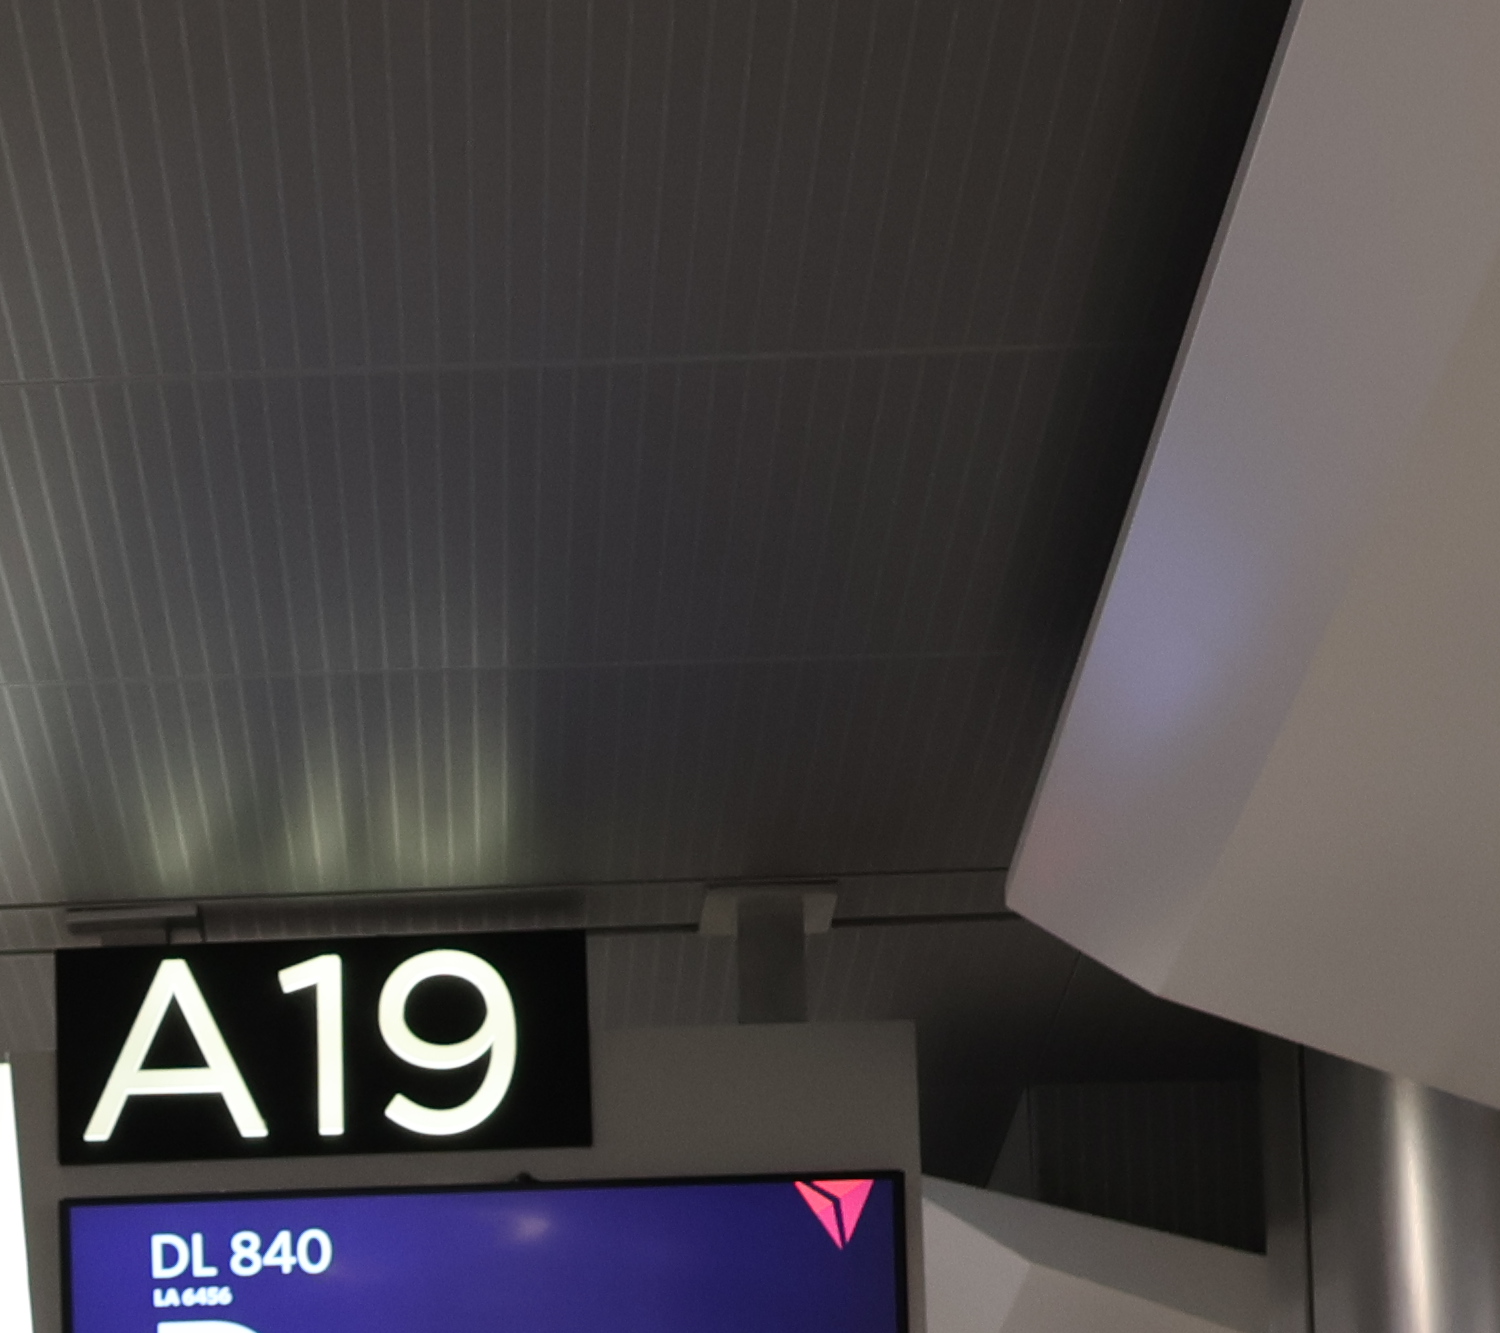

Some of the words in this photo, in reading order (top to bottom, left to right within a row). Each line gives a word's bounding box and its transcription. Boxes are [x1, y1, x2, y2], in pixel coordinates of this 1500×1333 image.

[82, 948, 519, 1143] A19
[150, 1231, 219, 1280] DL
[229, 1227, 333, 1277] 840
[152, 1287, 180, 1308] LA
